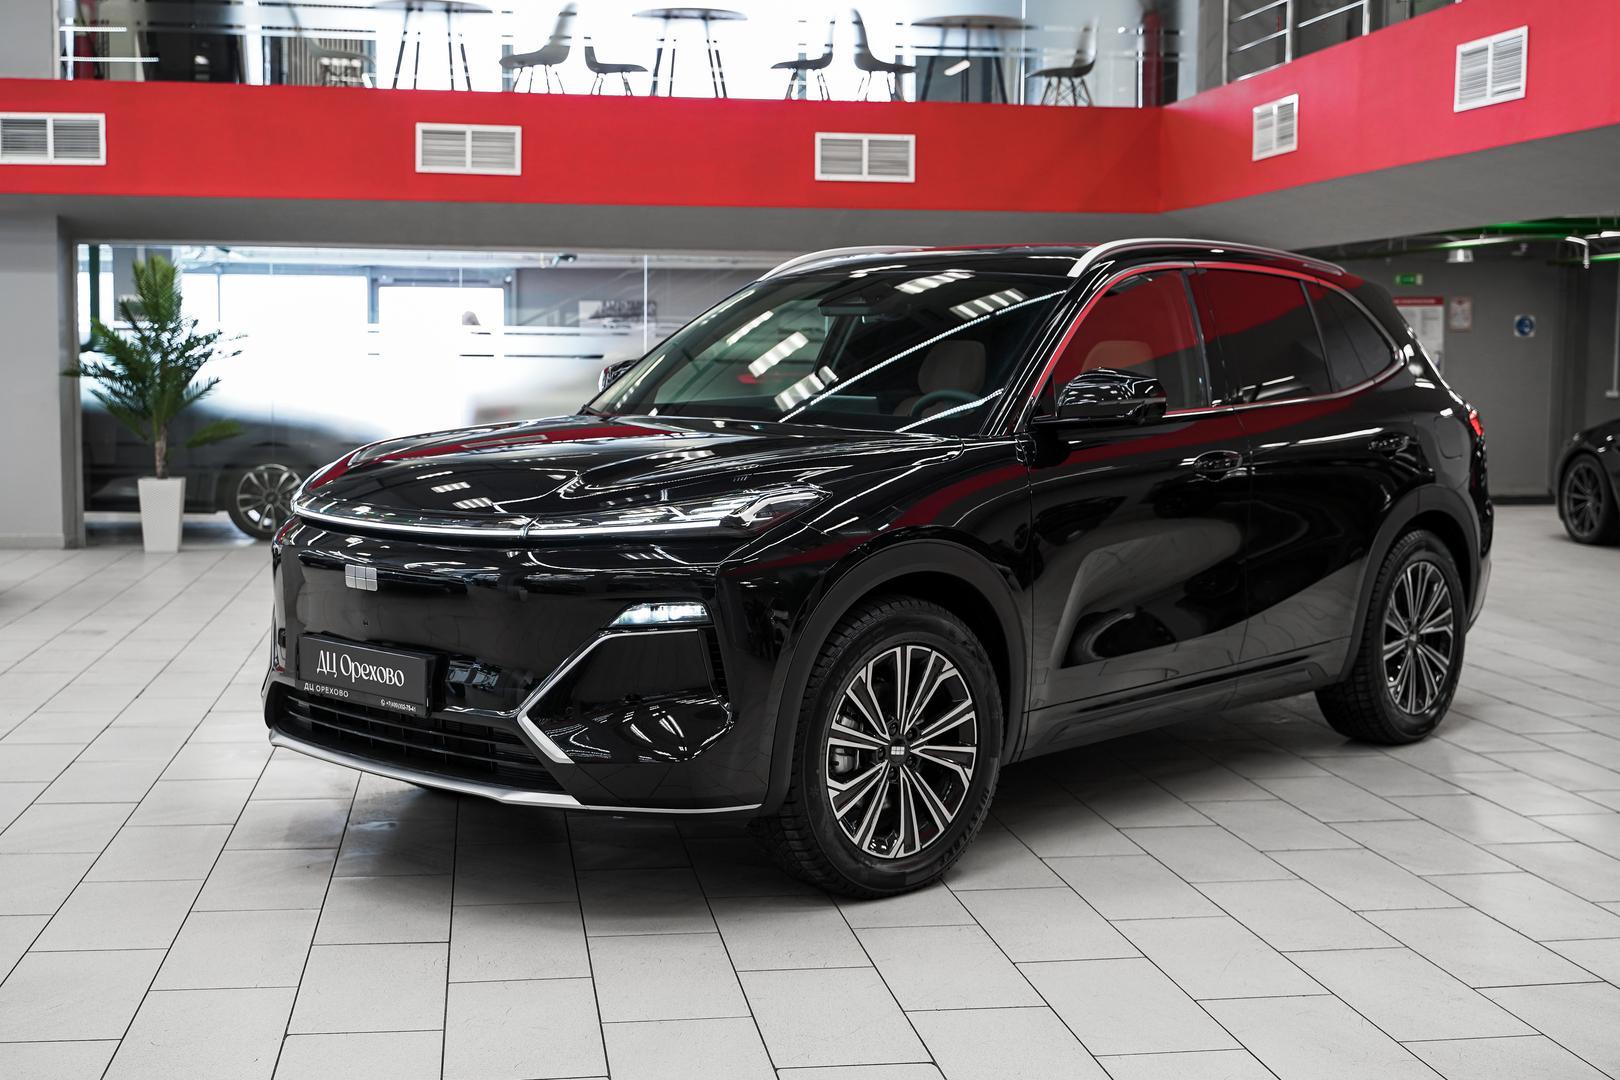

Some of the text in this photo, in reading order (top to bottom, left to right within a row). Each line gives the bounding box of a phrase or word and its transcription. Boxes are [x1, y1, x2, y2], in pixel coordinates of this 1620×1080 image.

[316, 649, 405, 687] ДЦ Орехово
[303, 682, 349, 698] ДЦ ОРЕХОВО
